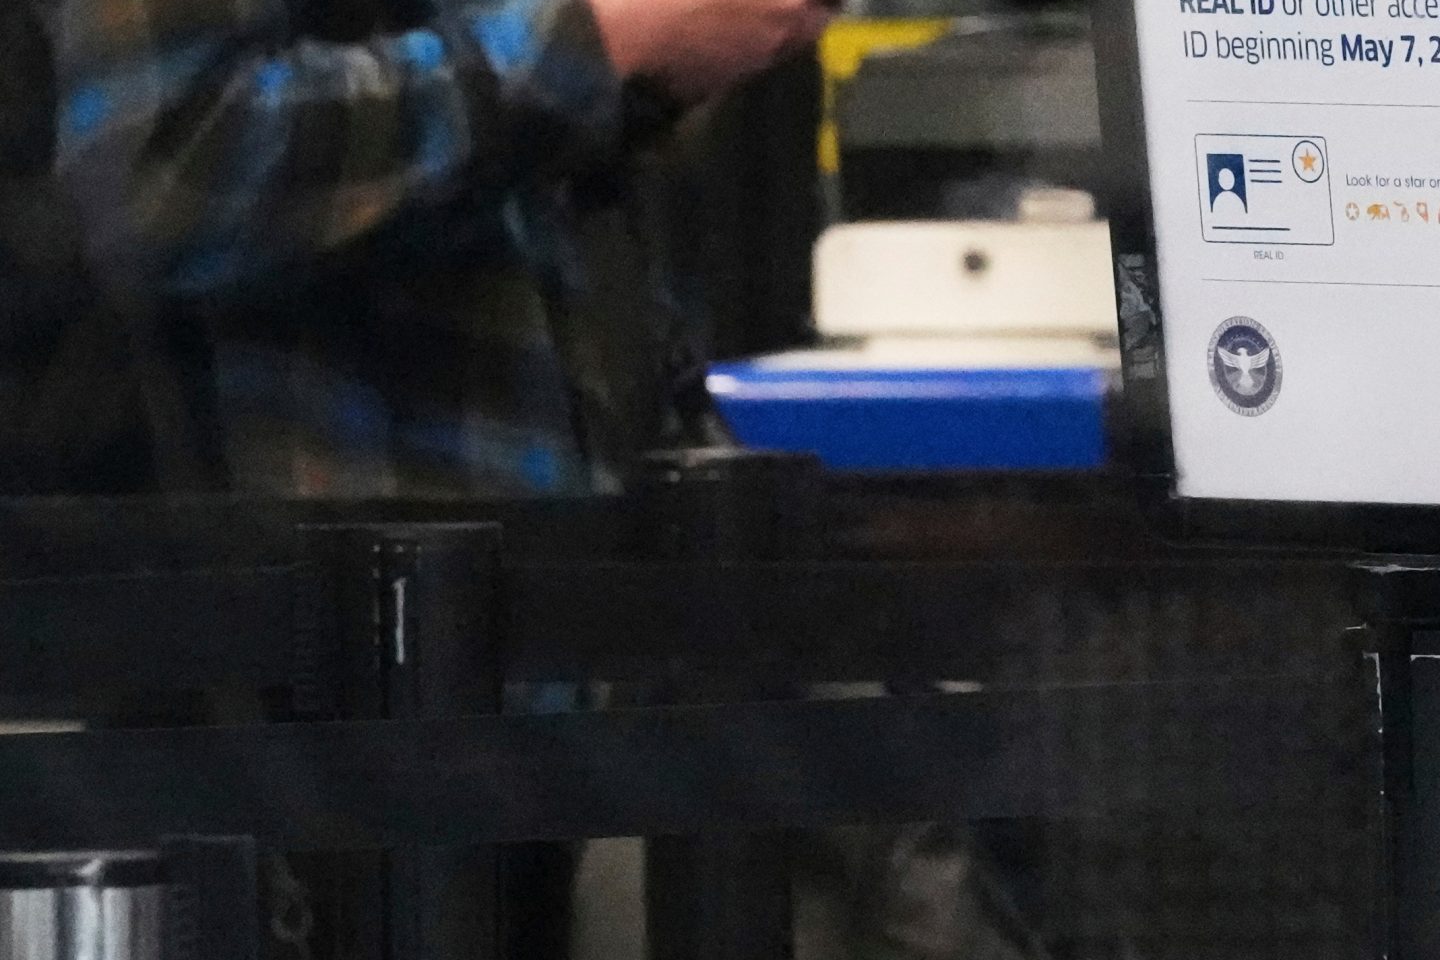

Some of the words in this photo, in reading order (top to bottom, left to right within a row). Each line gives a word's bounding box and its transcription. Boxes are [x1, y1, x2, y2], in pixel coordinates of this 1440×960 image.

[1184, 31, 1207, 58] ID
[1216, 30, 1335, 66] beginning
[1341, 34, 1393, 68] May
[1400, 35, 1423, 67] 7,
[1346, 174, 1372, 186] Look
[1376, 175, 1389, 187] for
[1393, 178, 1401, 187] a
[1405, 176, 1425, 188] star
[1429, 179, 1440, 188] or
[1254, 251, 1273, 259] REAL
[1276, 251, 1284, 260] ID
